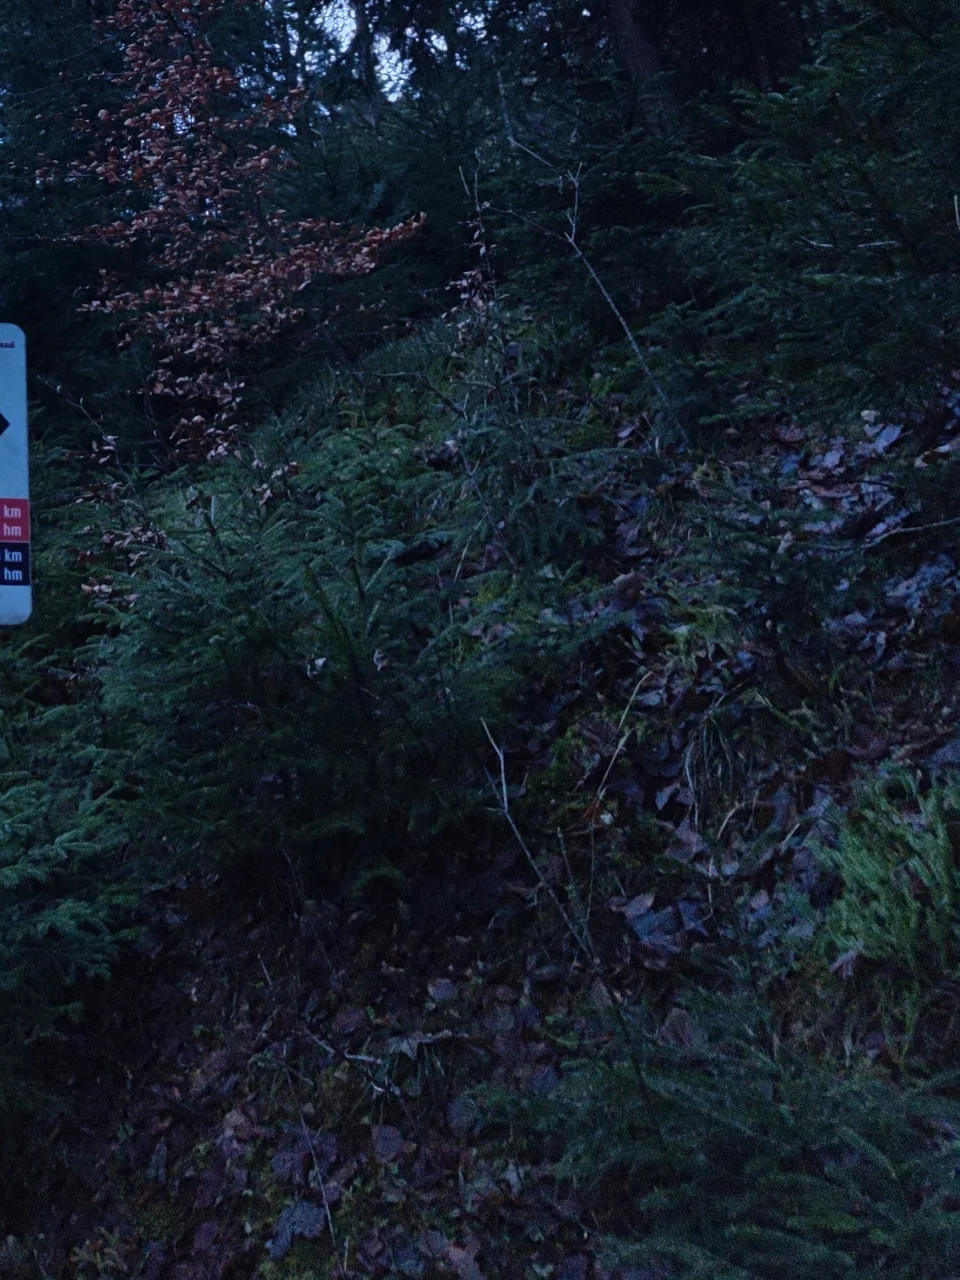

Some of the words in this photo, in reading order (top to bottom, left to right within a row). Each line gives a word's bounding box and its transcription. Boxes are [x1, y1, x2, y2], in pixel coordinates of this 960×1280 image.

[3, 504, 22, 519] km
[2, 523, 22, 537] hm
[4, 548, 23, 563] km
[3, 567, 23, 581] hm
